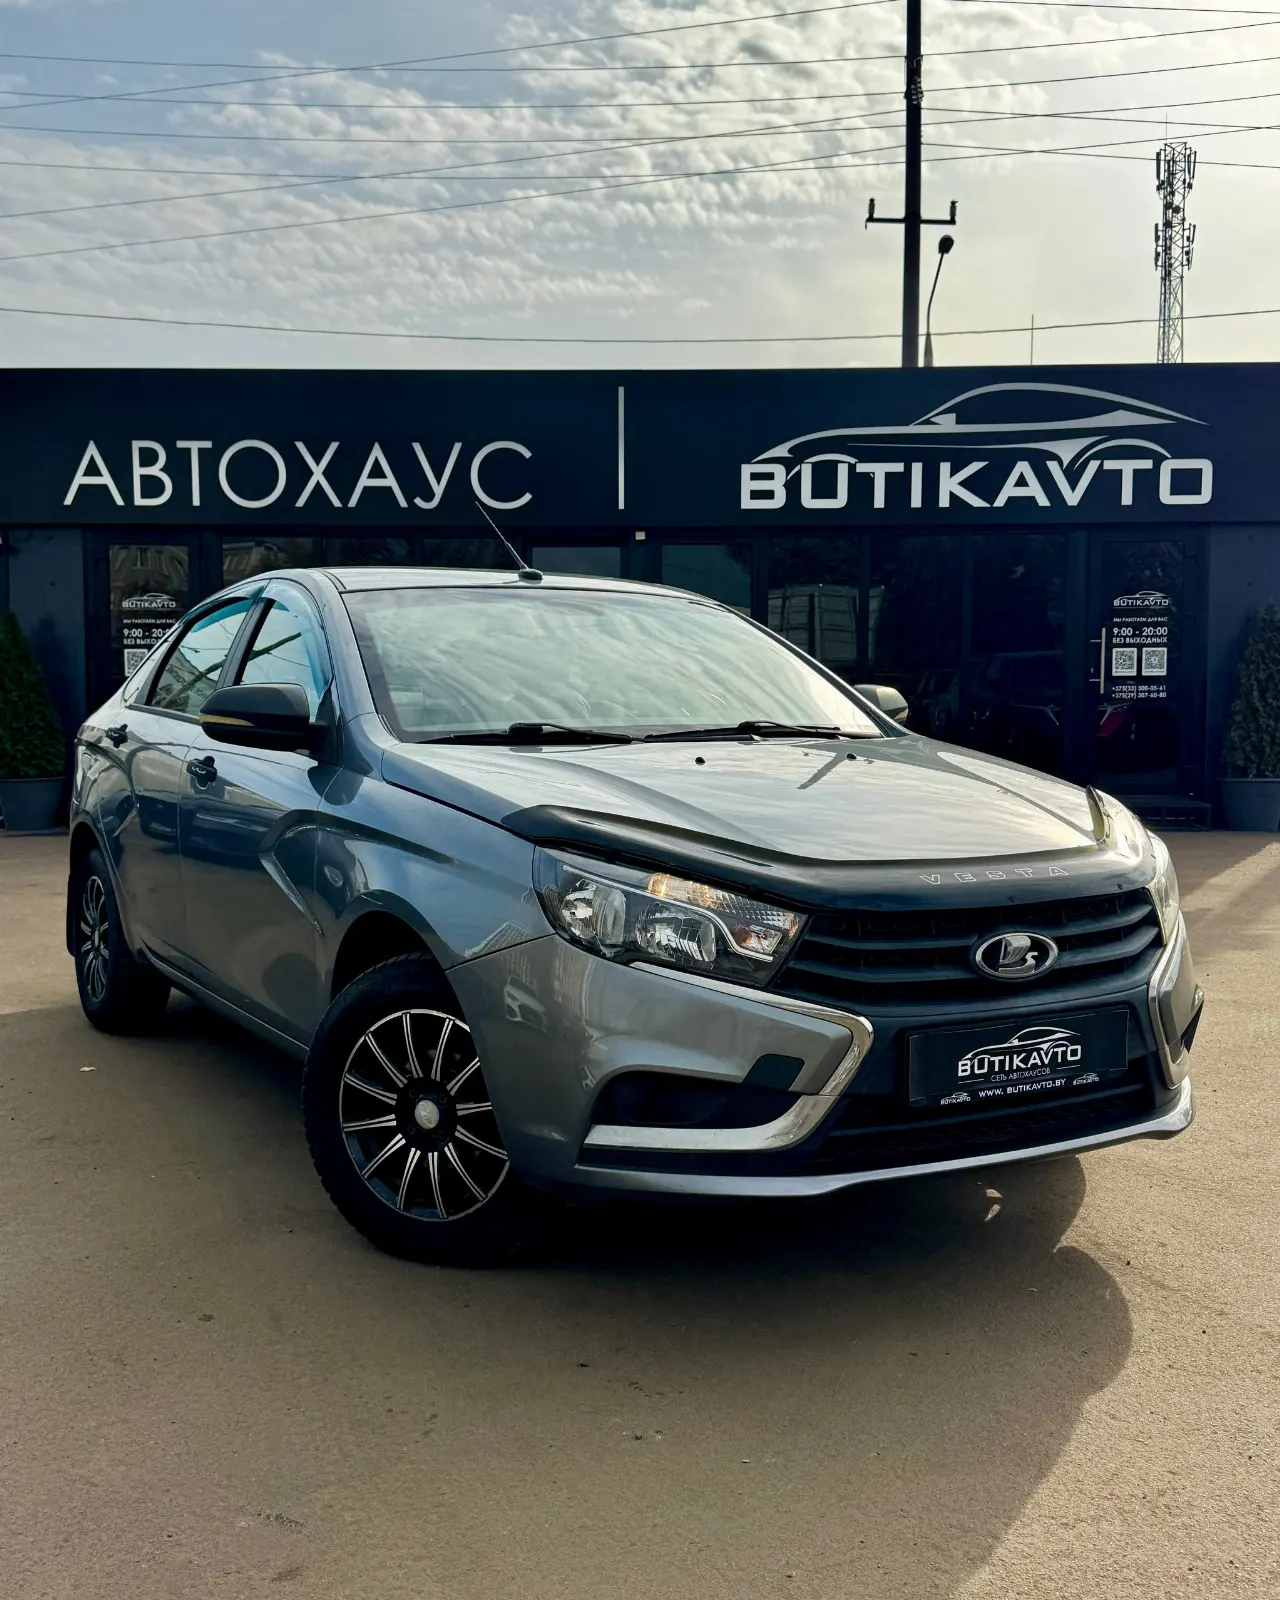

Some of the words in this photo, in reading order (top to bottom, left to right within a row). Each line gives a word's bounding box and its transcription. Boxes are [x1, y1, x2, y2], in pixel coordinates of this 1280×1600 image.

[63, 439, 533, 510] АВТОХАУС
[740, 458, 1214, 510] BUTIKAVTO
[1113, 599, 1169, 607] BUTIKAVTO
[123, 628, 142, 637] 9:00
[1142, 627, 1167, 635] 20:00
[1125, 636, 1168, 644] ВЫХОДНЫХ
[919, 866, 1069, 885] VESTA
[957, 1044, 1082, 1077] BUTIKAVTO
[991, 1073, 1007, 1082] СЕТЬ
[1008, 1067, 1051, 1080] АВТОХАУСОВ
